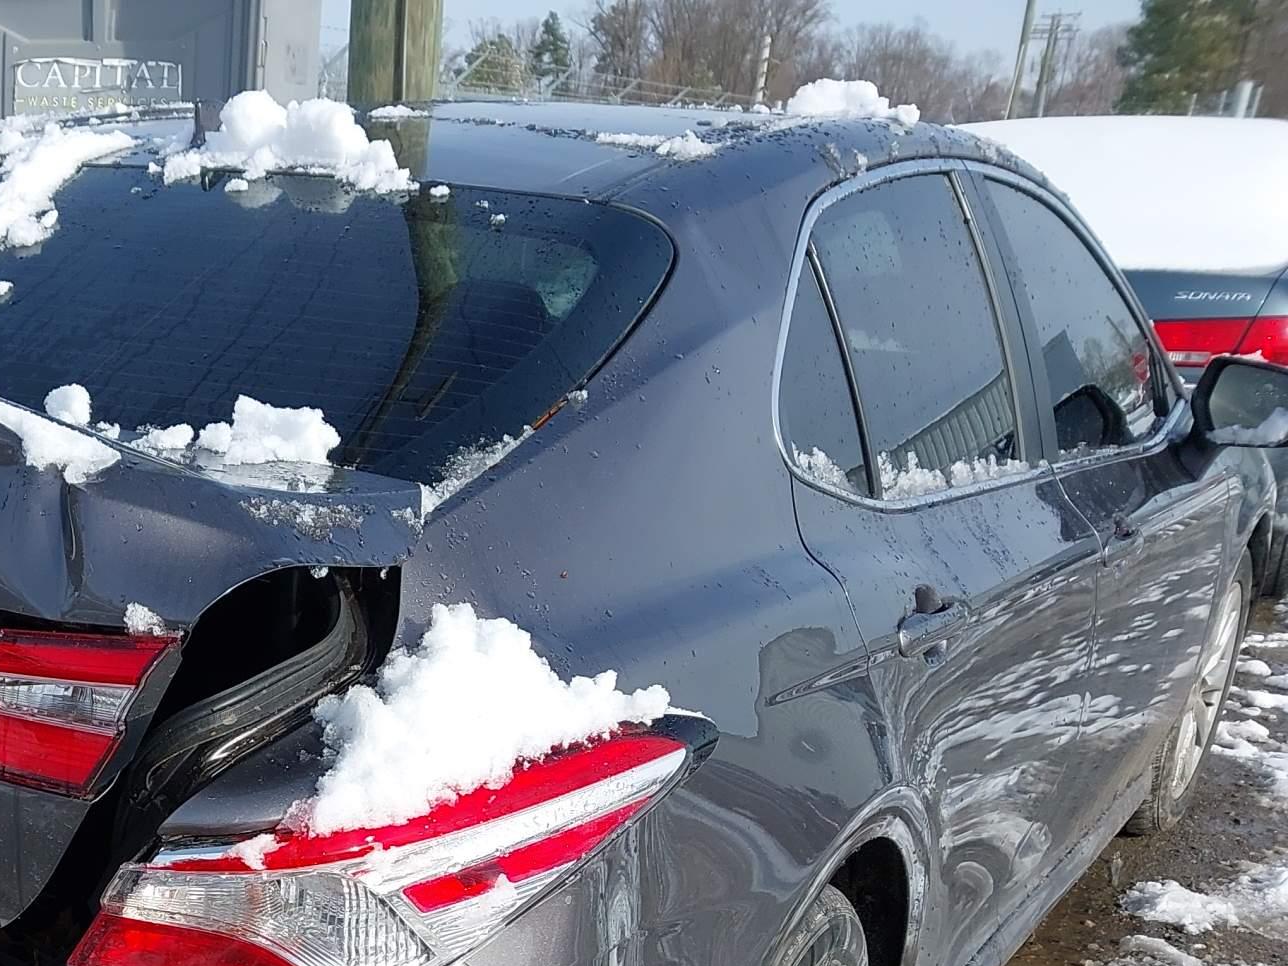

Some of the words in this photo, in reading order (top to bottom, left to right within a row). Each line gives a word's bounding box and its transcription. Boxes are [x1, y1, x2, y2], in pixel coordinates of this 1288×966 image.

[16, 61, 179, 89] CAPITAL
[27, 96, 77, 108] WASTE
[87, 96, 168, 109] SERVICES
[1173, 290, 1252, 301] SONATA
